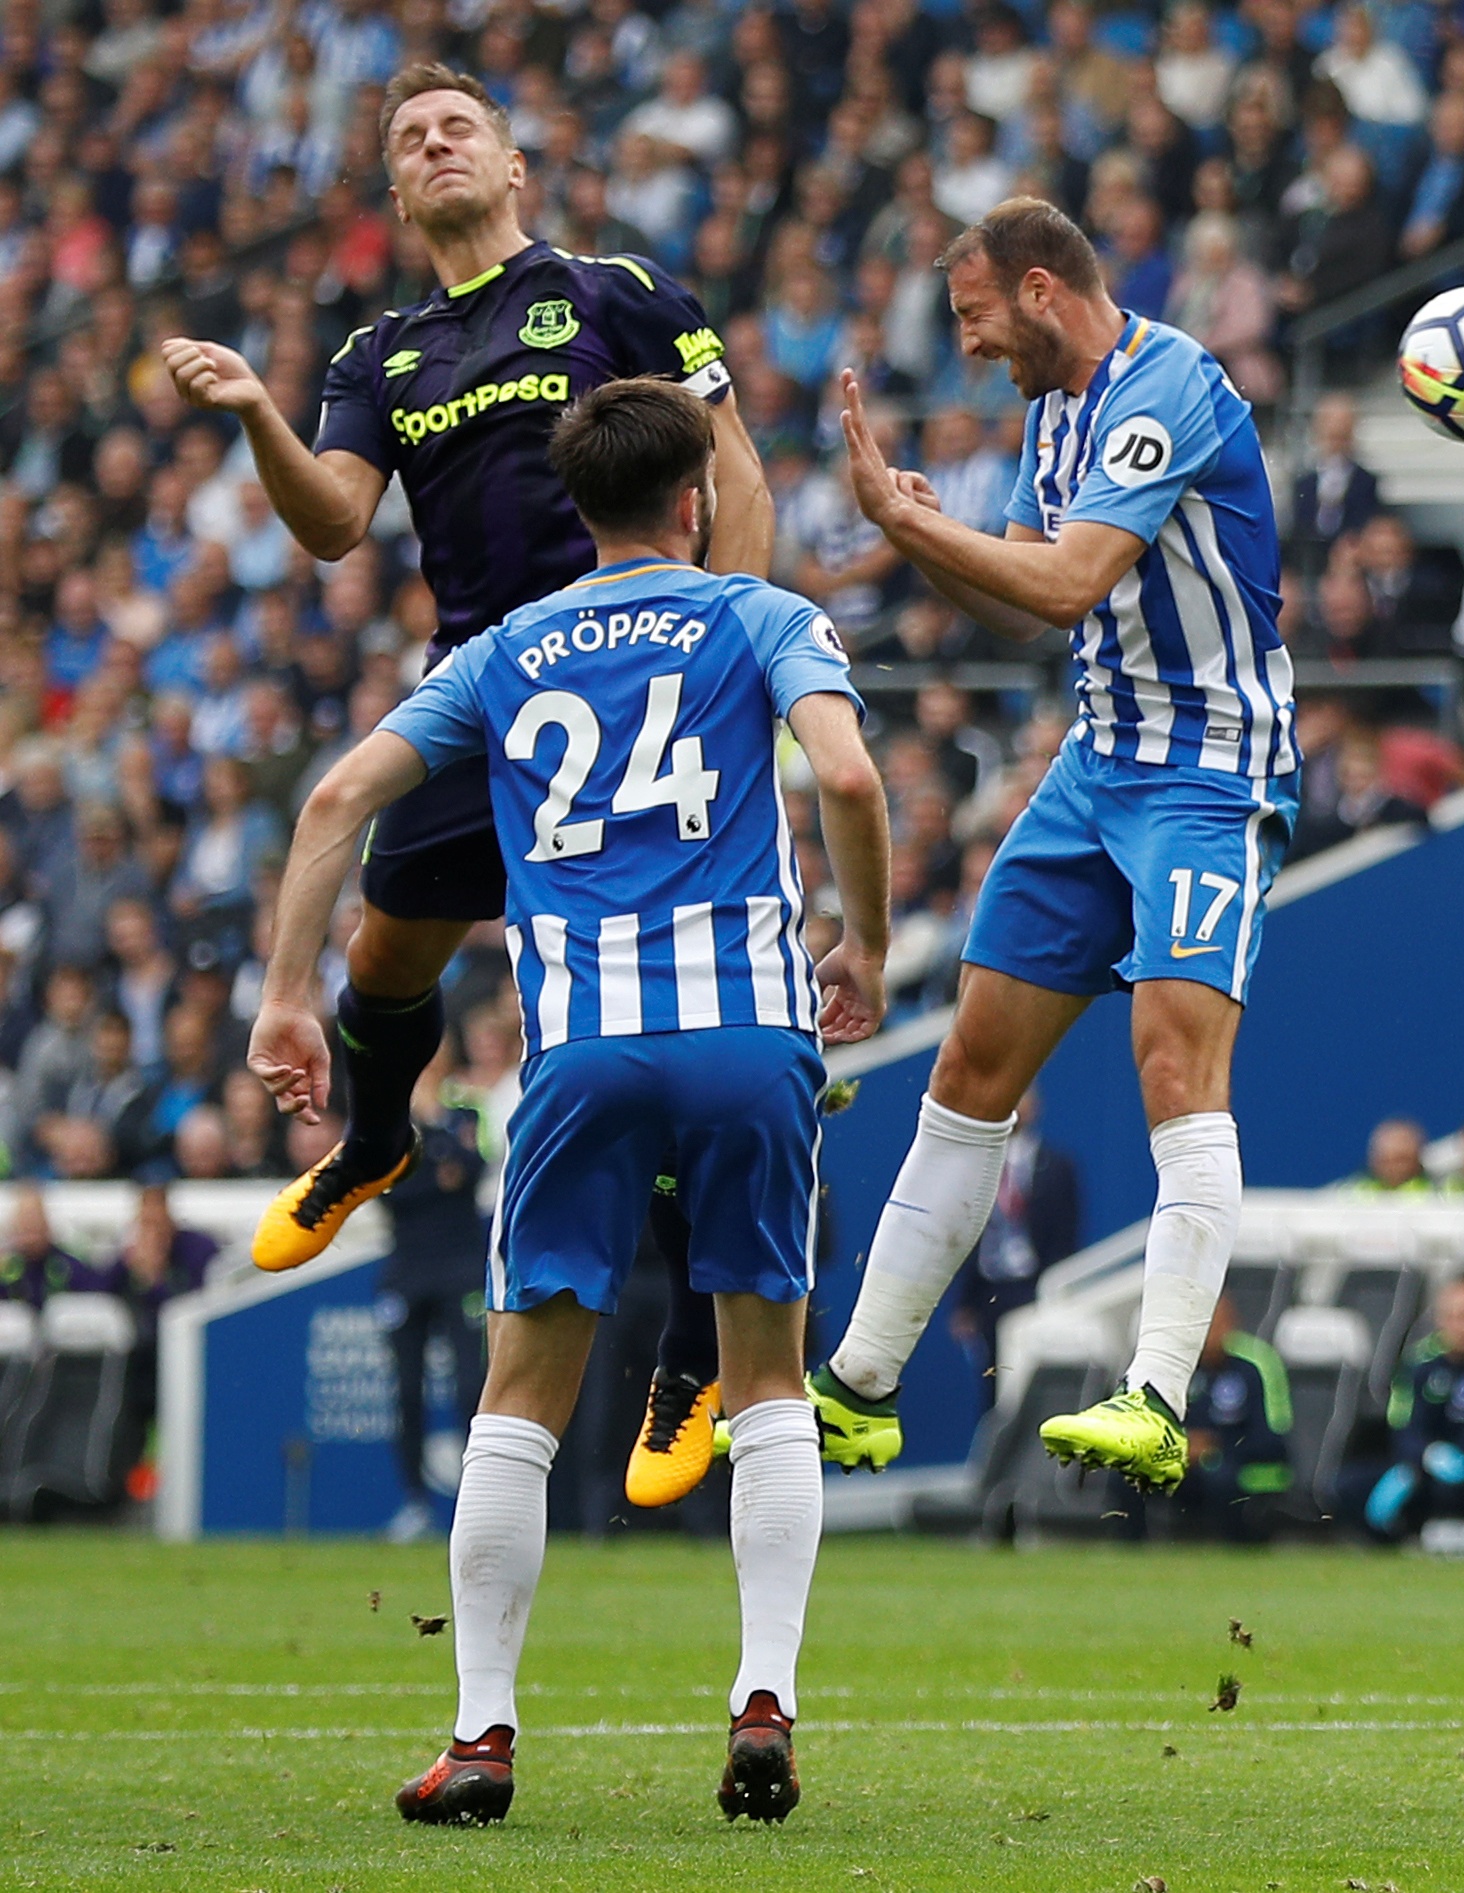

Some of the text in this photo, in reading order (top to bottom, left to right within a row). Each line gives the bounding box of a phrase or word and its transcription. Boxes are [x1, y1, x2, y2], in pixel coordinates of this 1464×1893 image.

[1108, 432, 1164, 472] JD
[517, 610, 706, 680] PRÖPPER
[503, 673, 720, 863] 24
[1168, 868, 1240, 941] 17
